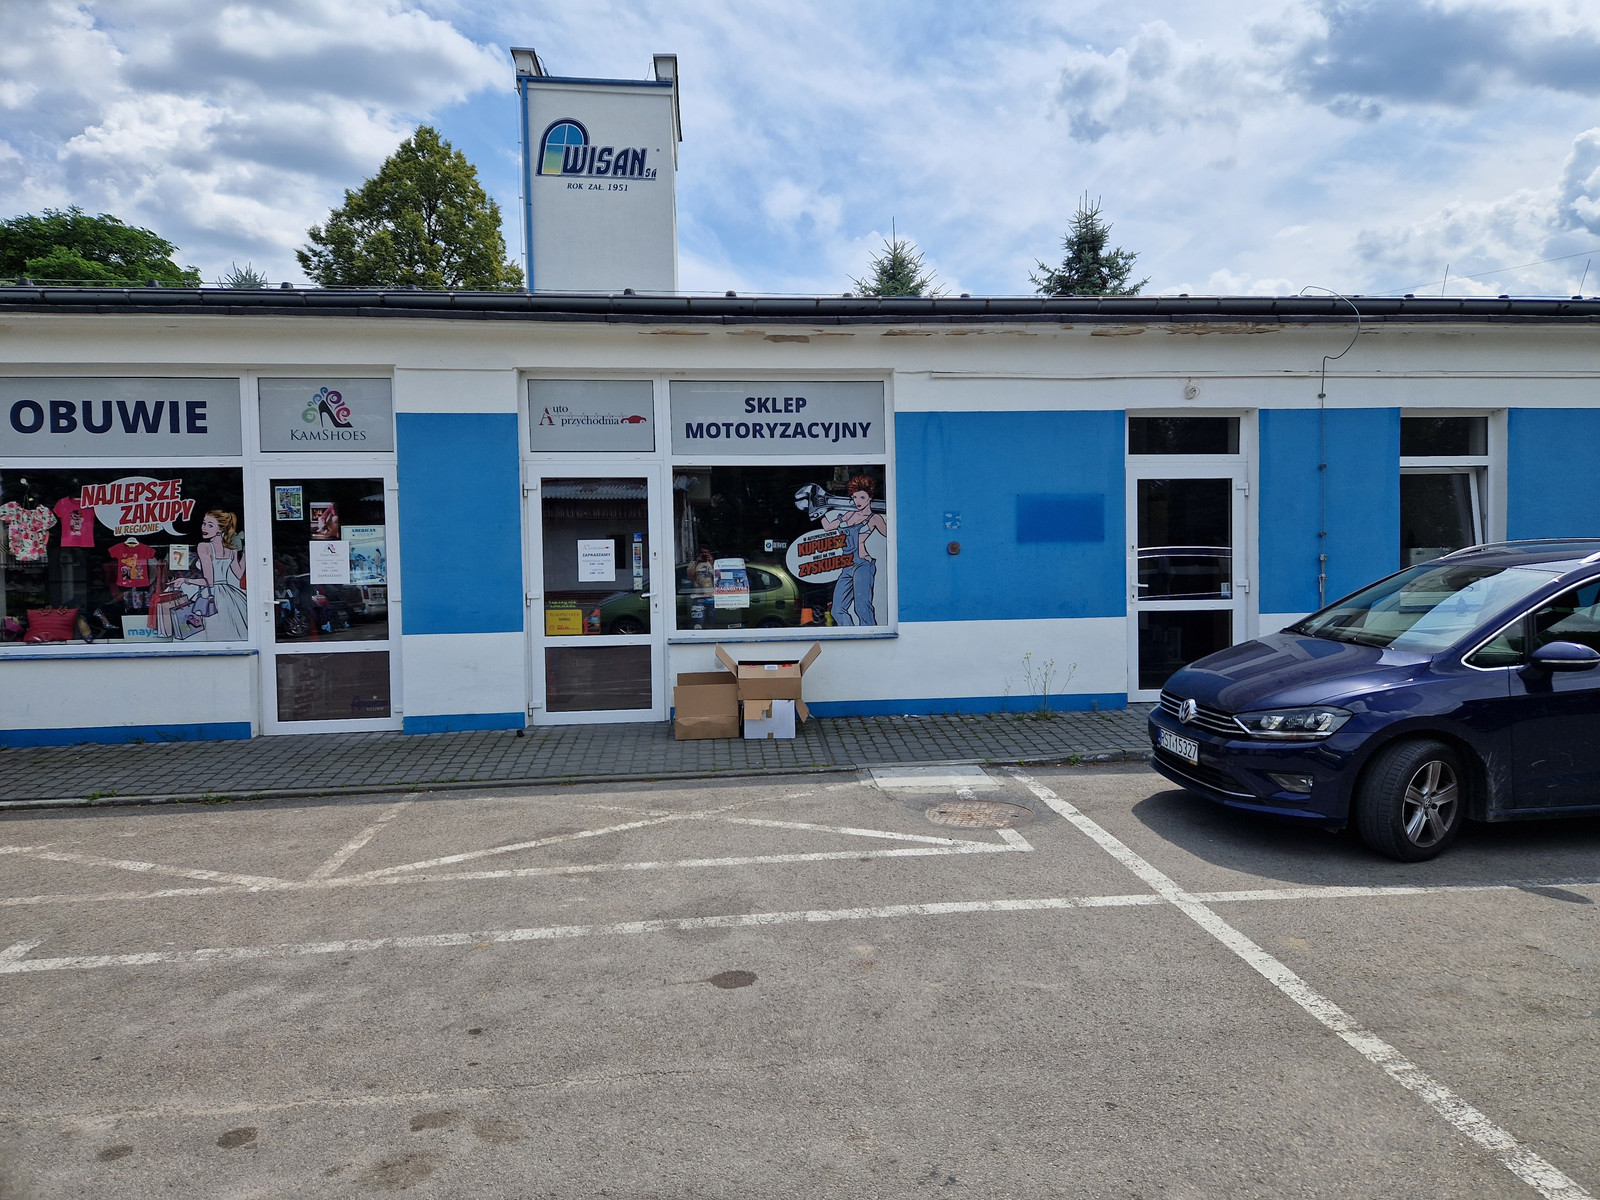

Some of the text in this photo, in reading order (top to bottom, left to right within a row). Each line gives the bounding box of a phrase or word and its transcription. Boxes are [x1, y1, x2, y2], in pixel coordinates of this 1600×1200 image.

[562, 145, 647, 177] WISAN
[588, 183, 605, 191] ZAŁ.
[608, 183, 629, 191] 1951
[9, 399, 208, 434] OBUWIE
[744, 397, 807, 414] SKLEP
[561, 414, 620, 427] przychodnia
[685, 422, 872, 443] MOTORYZACYJNY
[80, 479, 182, 507] NAJLEPSZE
[119, 500, 194, 525] ZAKUPY
[115, 523, 159, 534] W REGIONIE
[798, 535, 847, 557] KUPUJESZ
[799, 554, 855, 577] ZYSKUJESZ
[1175, 738, 1197, 760] 15327
